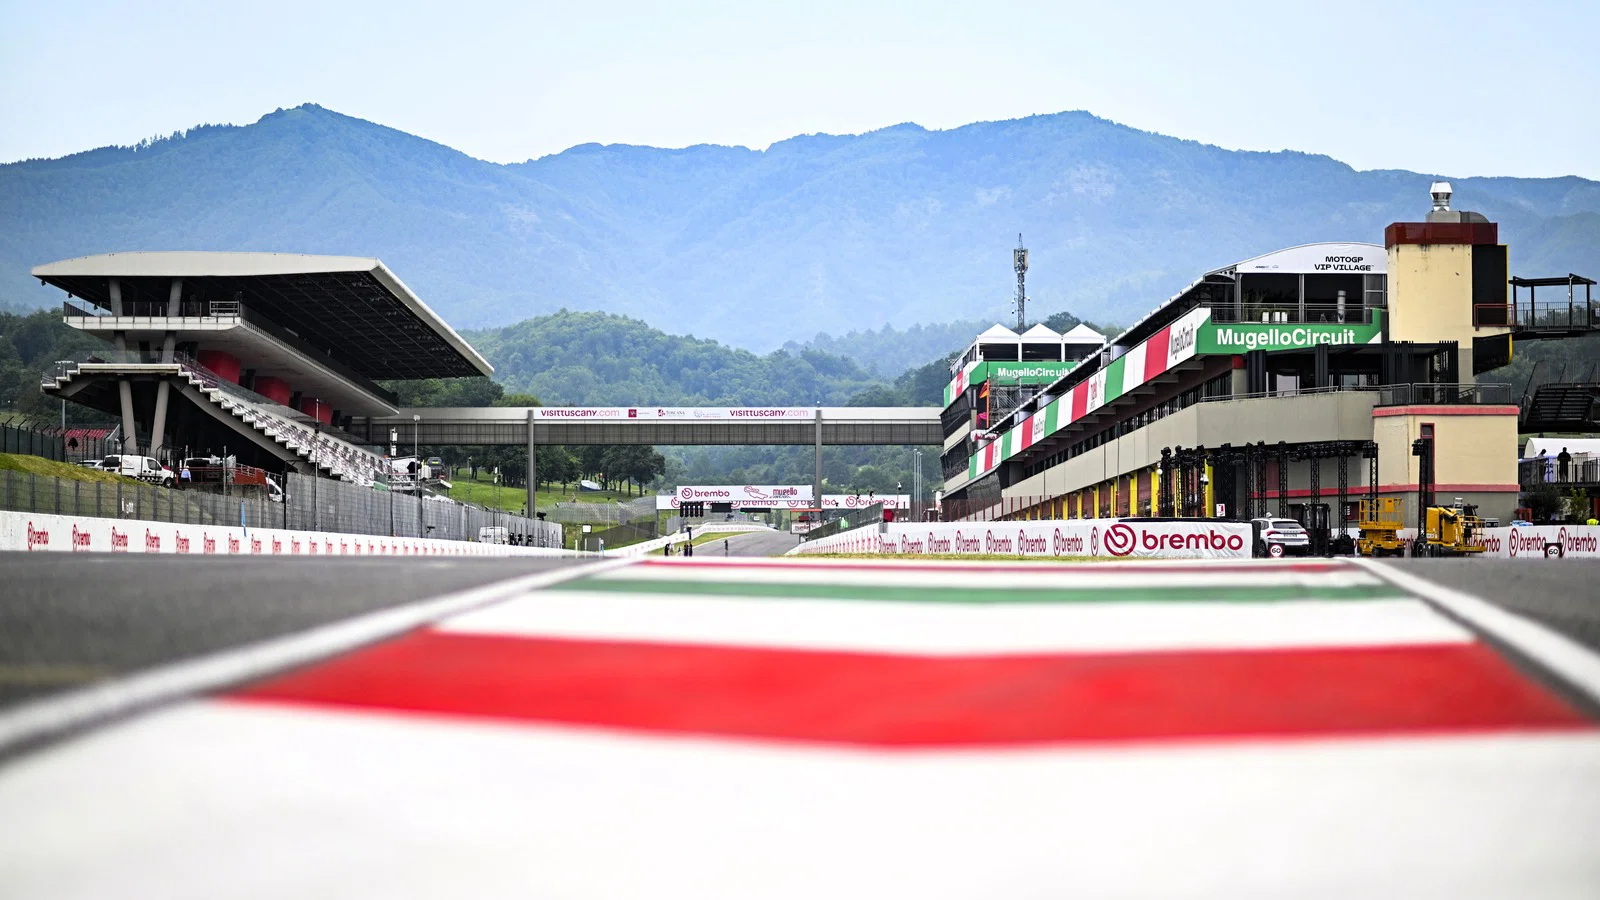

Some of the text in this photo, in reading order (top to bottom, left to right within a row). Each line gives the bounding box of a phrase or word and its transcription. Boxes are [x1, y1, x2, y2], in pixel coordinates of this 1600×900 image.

[1325, 255, 1364, 263] MOTOGP
[1216, 328, 1356, 349] MugelloCircuit
[540, 409, 620, 417] visittuscany.com
[729, 409, 809, 417] visittuscany.com
[694, 489, 730, 497] brembo
[772, 487, 798, 497] mugello
[32, 526, 49, 545] brembo
[962, 535, 980, 552] brembo
[993, 534, 1012, 552] brembo
[1026, 534, 1047, 552] brembo
[1062, 532, 1083, 552] brembo
[1142, 529, 1244, 551] brembo
[1520, 533, 1547, 552] brembo
[1567, 532, 1598, 553] brembo
[933, 536, 951, 553] brembo
[1271, 546, 1281, 554] 60
